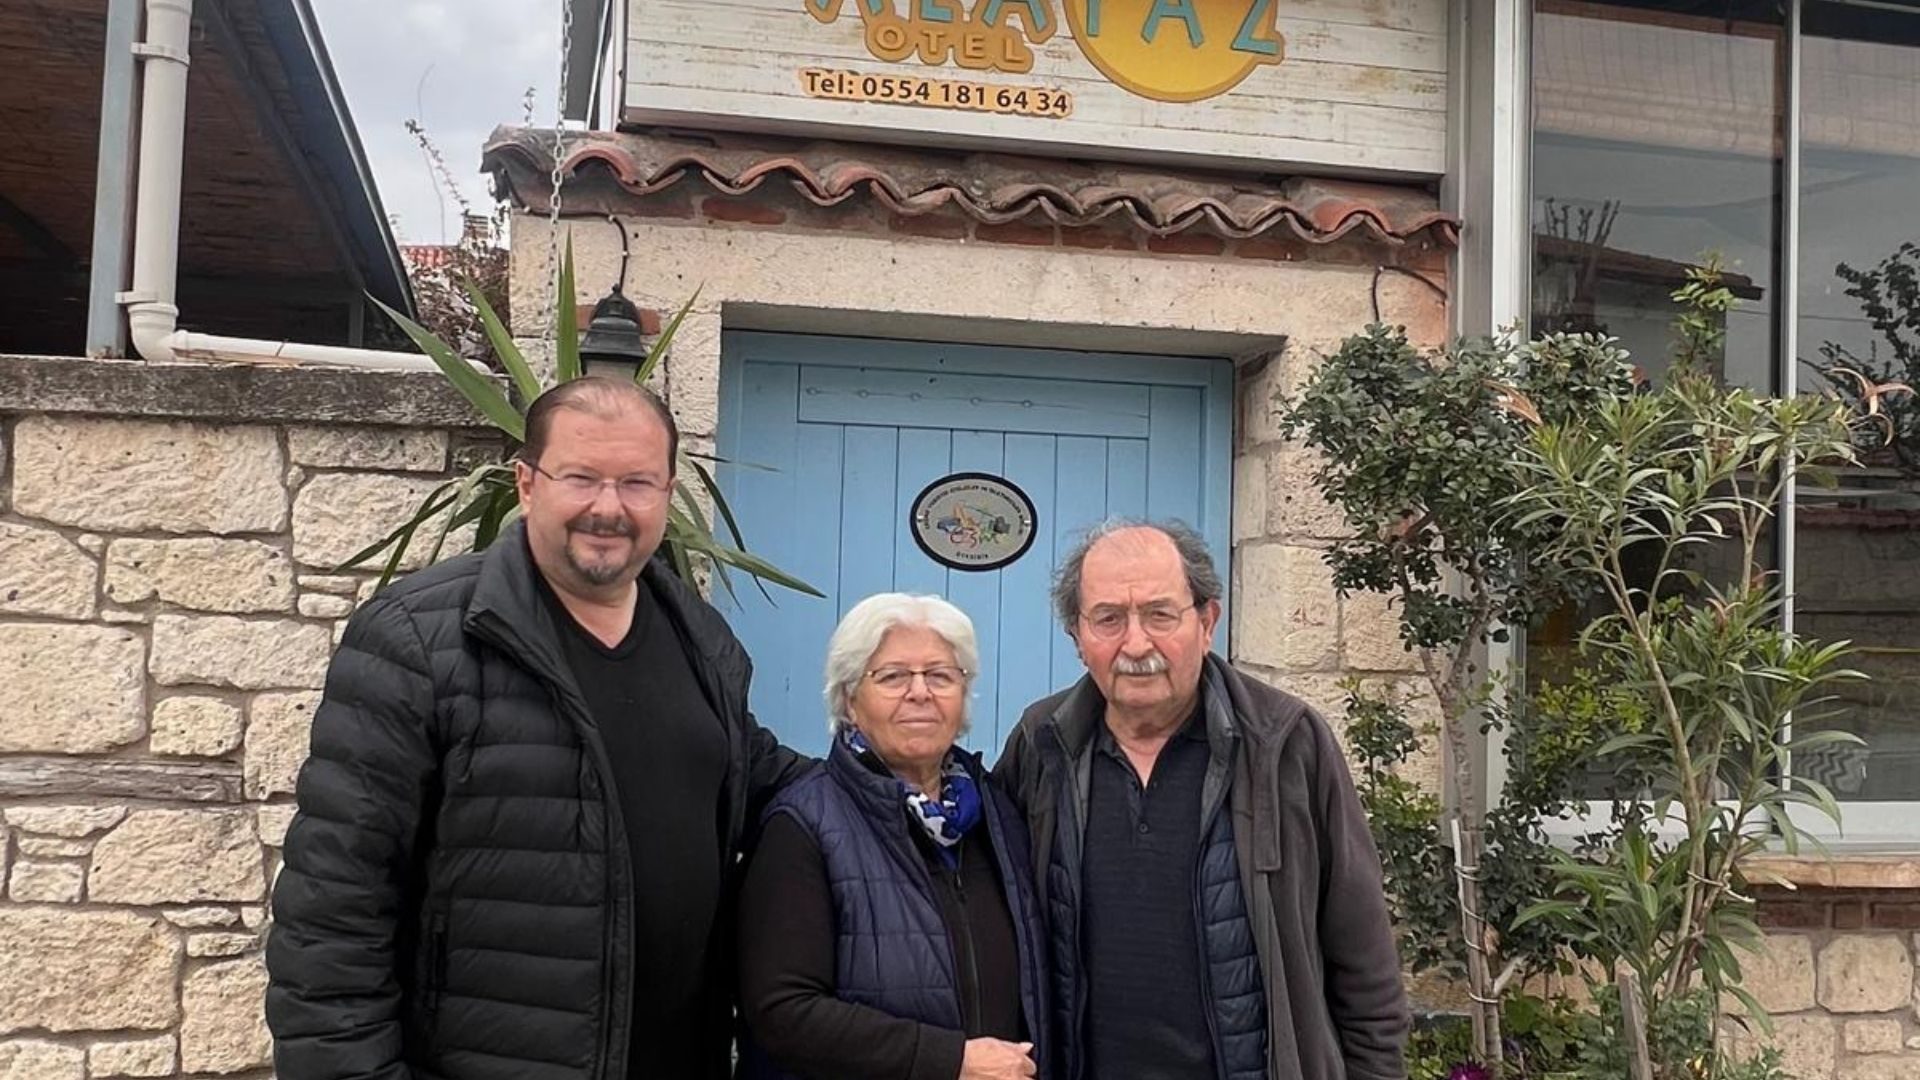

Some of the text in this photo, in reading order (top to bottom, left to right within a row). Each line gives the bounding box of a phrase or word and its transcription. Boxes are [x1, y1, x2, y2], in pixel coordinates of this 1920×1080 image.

[873, 24, 1026, 64] OTEL
[805, 71, 1068, 113] Tel: 0554 181 64 34
